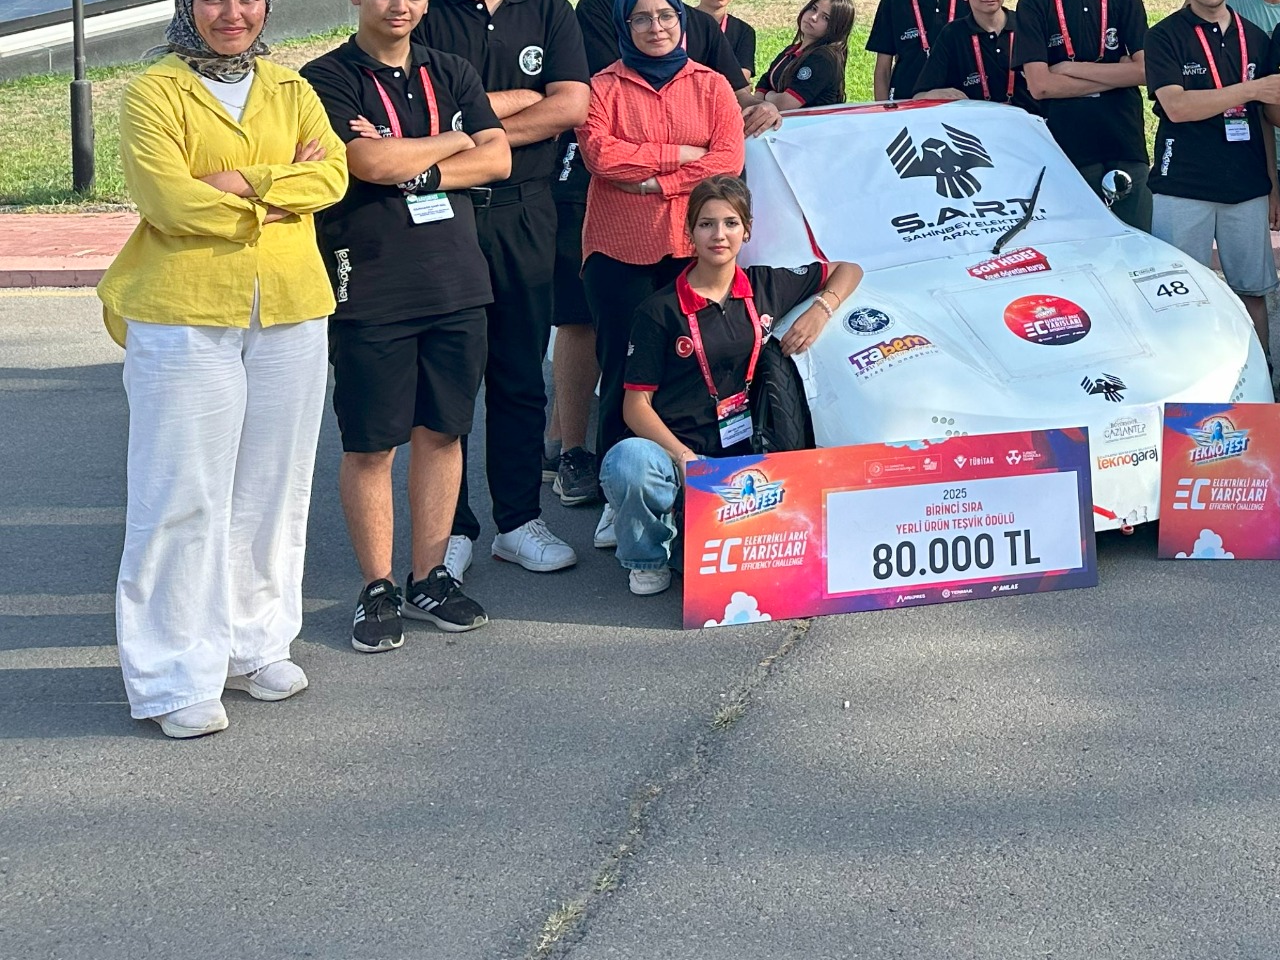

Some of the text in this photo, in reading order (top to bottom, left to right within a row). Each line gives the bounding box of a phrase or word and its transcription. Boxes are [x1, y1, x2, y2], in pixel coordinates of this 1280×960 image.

[902, 221, 971, 242] ŞAHİNBEY
[943, 230, 980, 241] ARAÇ
[972, 261, 1000, 275] SON
[998, 249, 1038, 266] HEDEF
[1156, 280, 1190, 297] 48
[1023, 320, 1048, 337] EC
[850, 335, 931, 368] Fabem
[1097, 445, 1158, 470] teknogaraj
[1189, 437, 1250, 462] TEKNOFEST
[969, 456, 994, 466] TÜBİTAK
[1213, 477, 1251, 488] ELEKTRİKLİ
[943, 488, 967, 500] 2025
[1173, 478, 1211, 510] EC
[1211, 487, 1267, 503] YARIŞLARI
[716, 489, 785, 522] TEKNOFEST
[925, 501, 983, 516] BİRİNCİ SIRA
[1209, 502, 1264, 511] EFFICIENCY CHALLENGE
[896, 512, 1015, 534] YERLİ ÜRÜN TEŞVİK ÖDÜLÜ
[744, 531, 787, 546] ELEKTRİKLİ
[699, 537, 742, 575] EC
[742, 541, 807, 560] YARIŞLARI
[873, 529, 1041, 580] 80.000 TL
[741, 557, 803, 571] EFFICIENCY CHALLENGE
